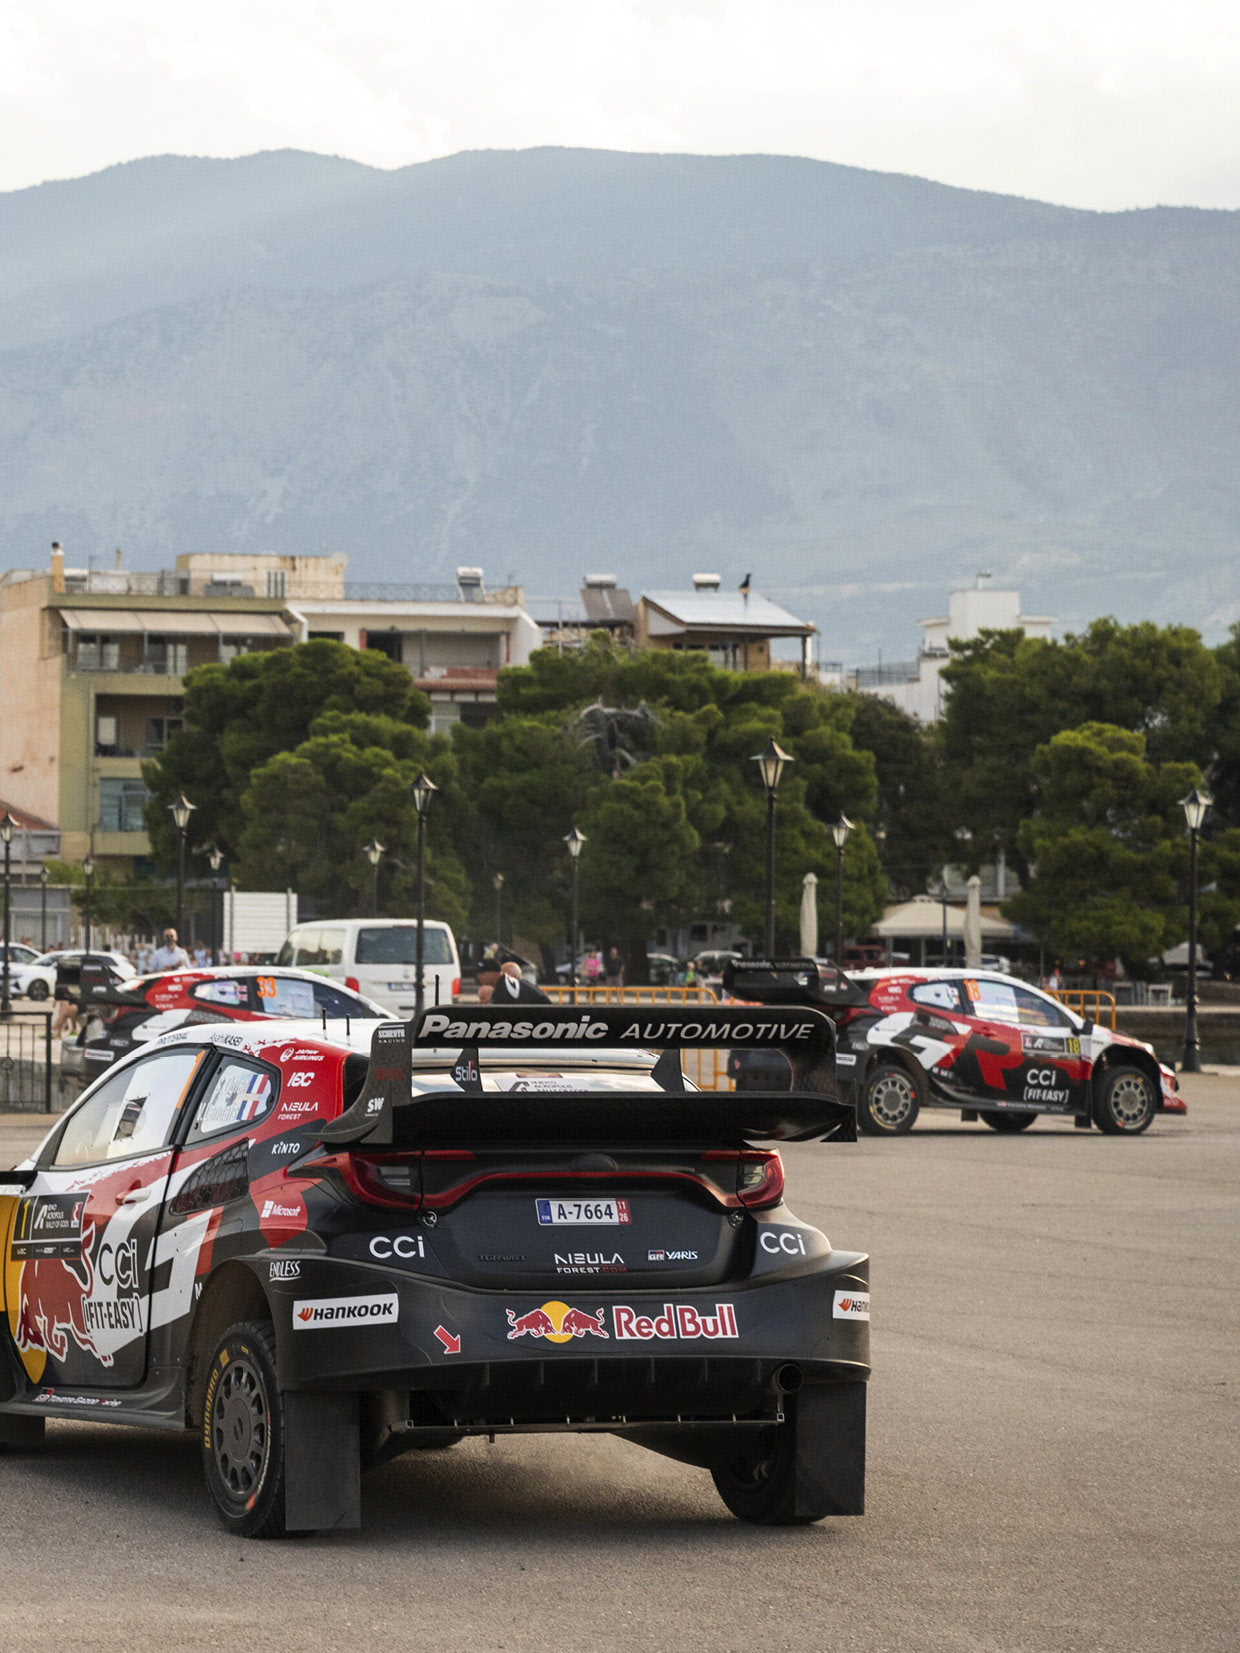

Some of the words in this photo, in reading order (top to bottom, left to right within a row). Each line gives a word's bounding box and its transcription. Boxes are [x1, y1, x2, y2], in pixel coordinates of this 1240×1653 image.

[256, 976, 277, 998] 33
[963, 979, 981, 1001] 18
[419, 1015, 610, 1040] Panasonic
[620, 1023, 815, 1041] AUTOMOTIVE
[1068, 1037, 1080, 1053] 18
[455, 1058, 477, 1082] Stilo
[271, 1204, 301, 1217] Microsoft
[557, 1203, 613, 1220] A-7664
[617, 1201, 626, 1209] 11
[619, 1213, 629, 1222] 26
[665, 1250, 698, 1260] YARIS
[269, 1260, 301, 1279] ENDLESS
